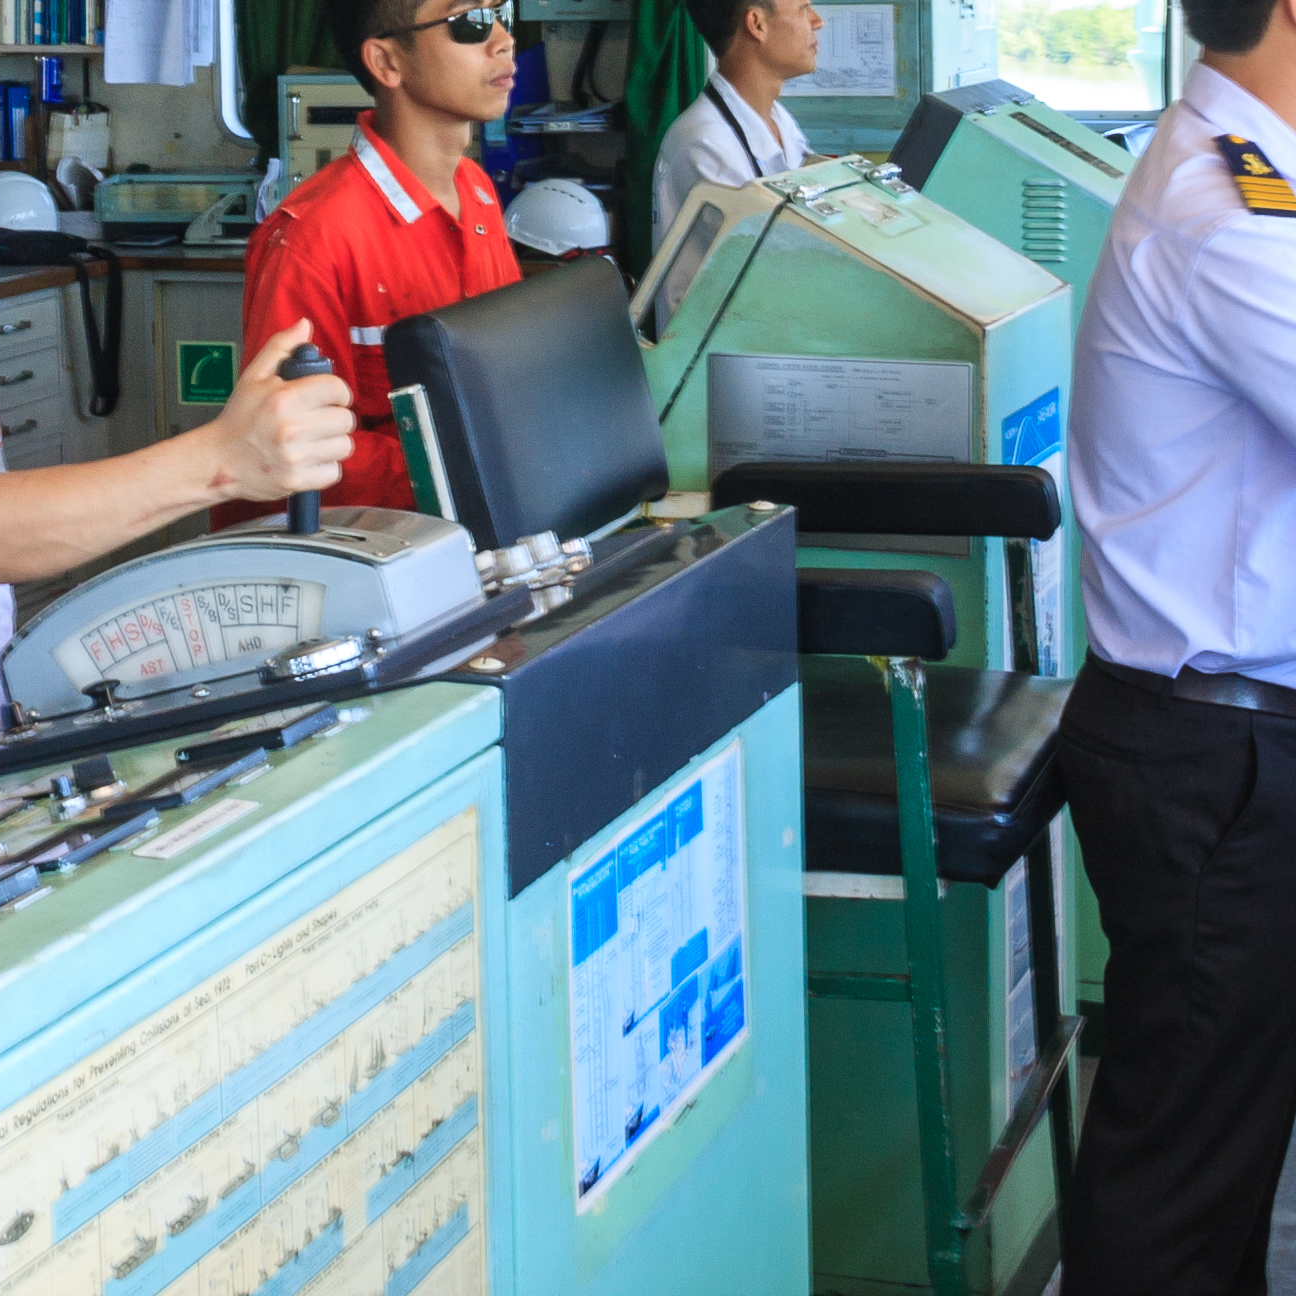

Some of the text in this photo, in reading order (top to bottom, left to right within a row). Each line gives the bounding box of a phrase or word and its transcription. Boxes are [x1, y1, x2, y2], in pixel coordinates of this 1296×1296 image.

[238, 594, 254, 614] S
[259, 595, 274, 613] H
[280, 596, 294, 614] F
[89, 640, 103, 661] F
[106, 631, 124, 649] H
[123, 622, 141, 641] S
[179, 598, 202, 658] STOP
[237, 636, 262, 653] AHD
[139, 657, 166, 676] AST
[294, 926, 310, 944] and
[311, 908, 338, 932] Shapes
[12, 1087, 69, 1130] Regulations
[72, 1075, 86, 1089] for
[88, 1042, 136, 1077] Preventing
[138, 1012, 180, 1045] Collisions
[182, 1001, 192, 1017] at
[213, 977, 232, 998] 1972
